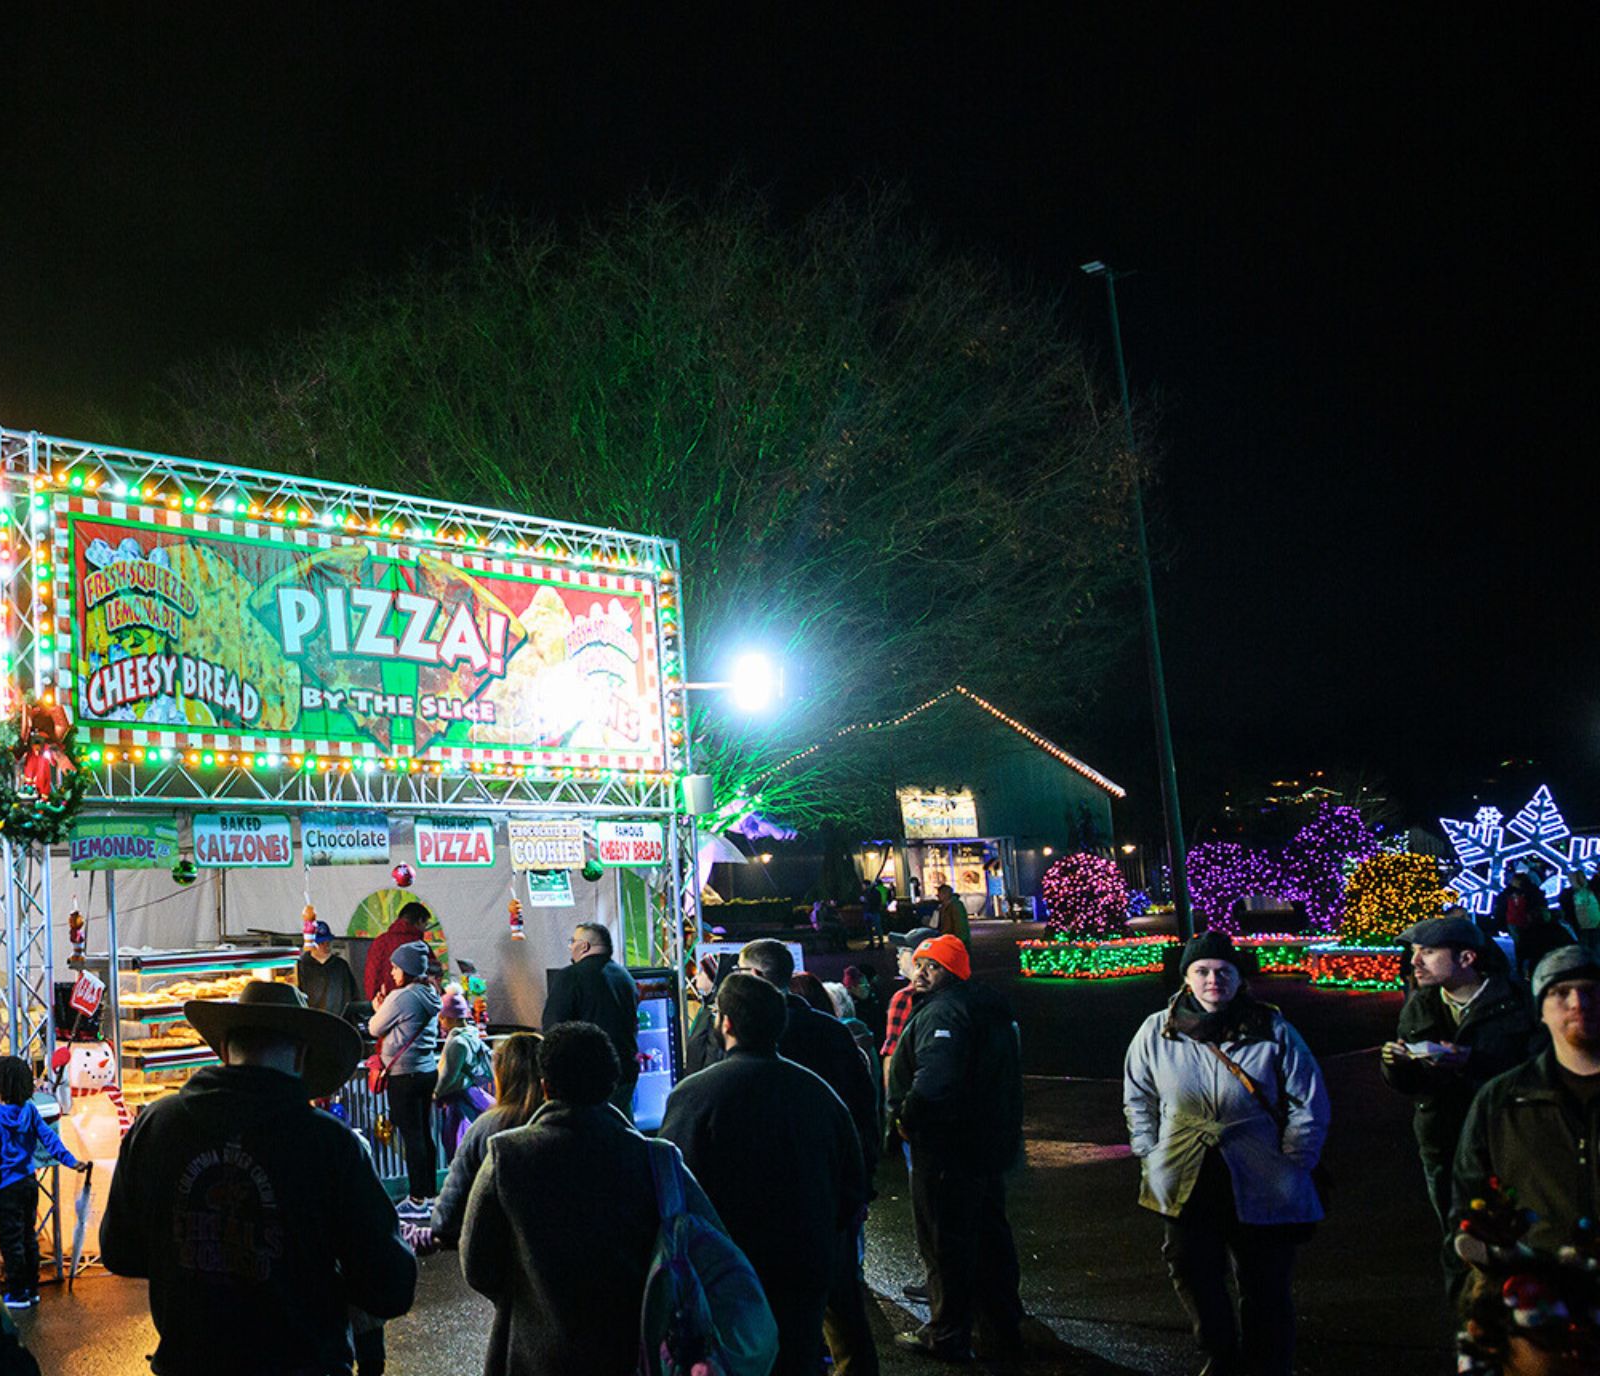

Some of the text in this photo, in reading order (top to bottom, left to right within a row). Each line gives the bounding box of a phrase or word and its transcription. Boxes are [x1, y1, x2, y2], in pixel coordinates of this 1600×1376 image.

[106, 596, 177, 636] LEMONADE
[277, 586, 509, 675] PIZZA!
[88, 653, 260, 720] CHEESY BREAD
[302, 686, 496, 722] BY THE SLICE
[220, 816, 262, 831] BAKED
[71, 836, 157, 862] LEMONADE
[196, 834, 289, 863] CALZONES
[305, 830, 387, 848] Chocolate
[419, 832, 491, 862] PIZZA
[513, 838, 583, 864] COOKIES
[600, 839, 662, 862] CHEESY BREAD
